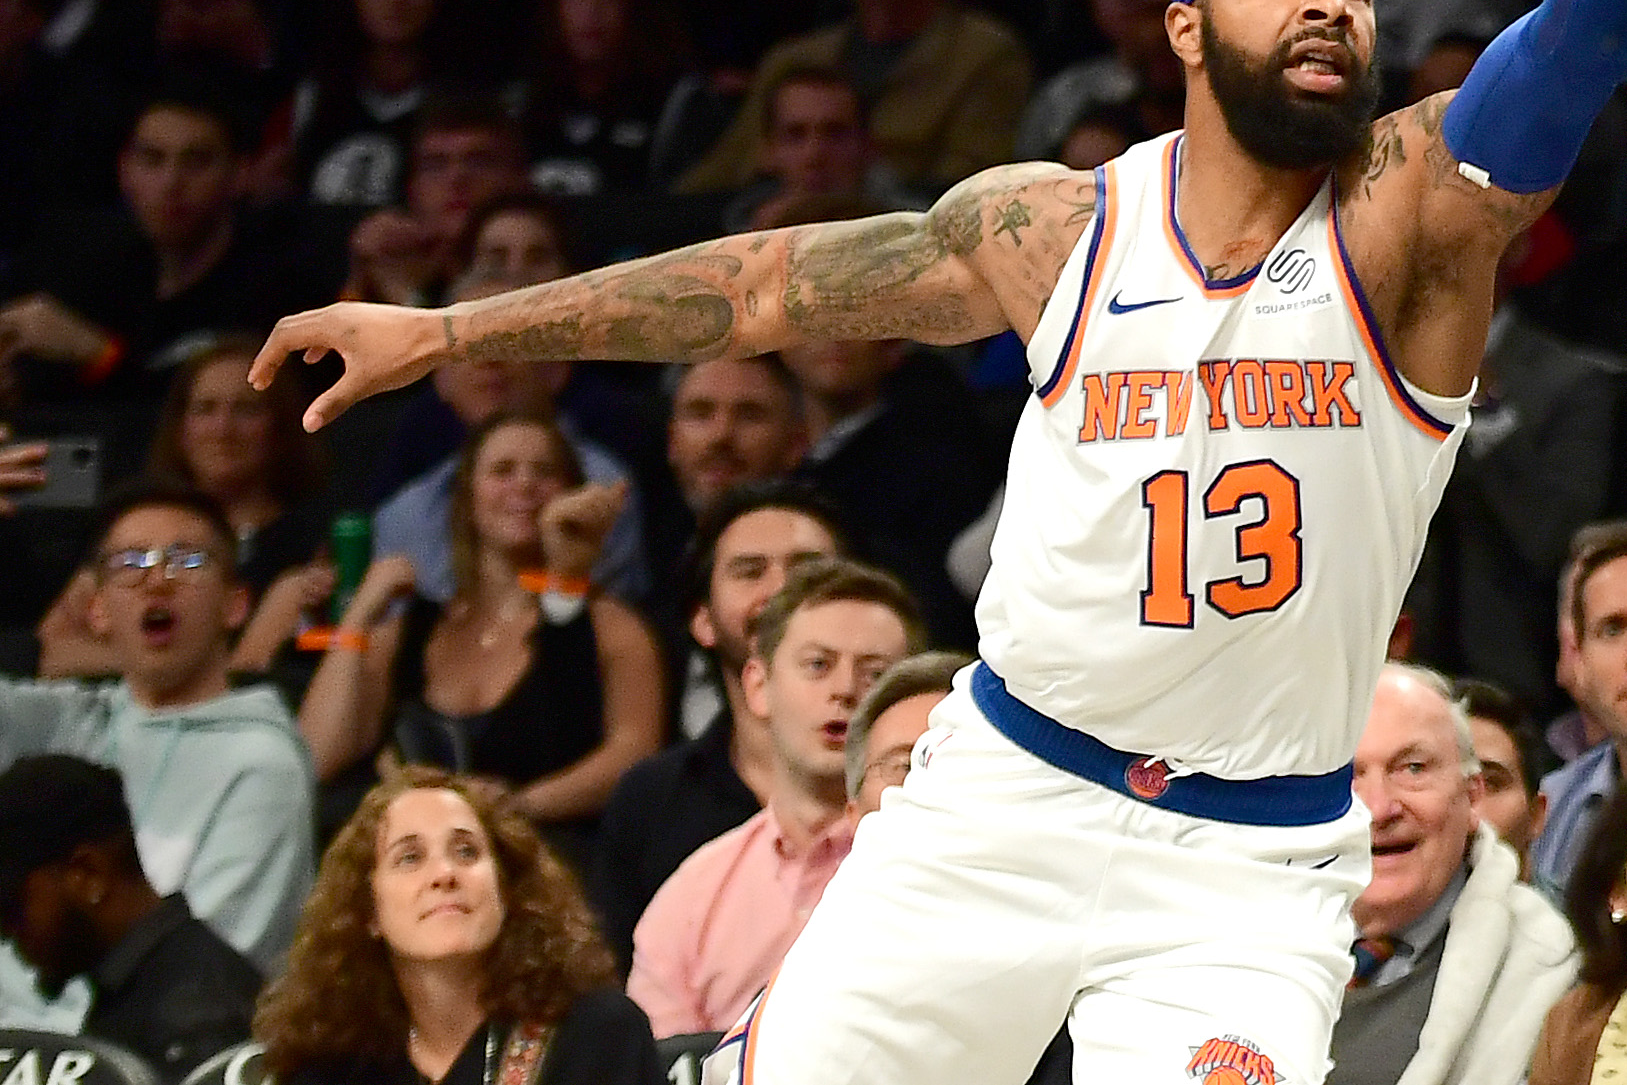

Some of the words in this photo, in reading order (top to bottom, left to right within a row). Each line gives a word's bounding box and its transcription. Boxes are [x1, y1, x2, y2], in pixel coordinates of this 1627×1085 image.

[1255, 293, 1333, 315] SQUARESPACE
[1076, 369, 1195, 445] NEW
[1197, 358, 1364, 430] YORK
[1139, 458, 1303, 630] 13
[1185, 1037, 1276, 1085] KNICKS
